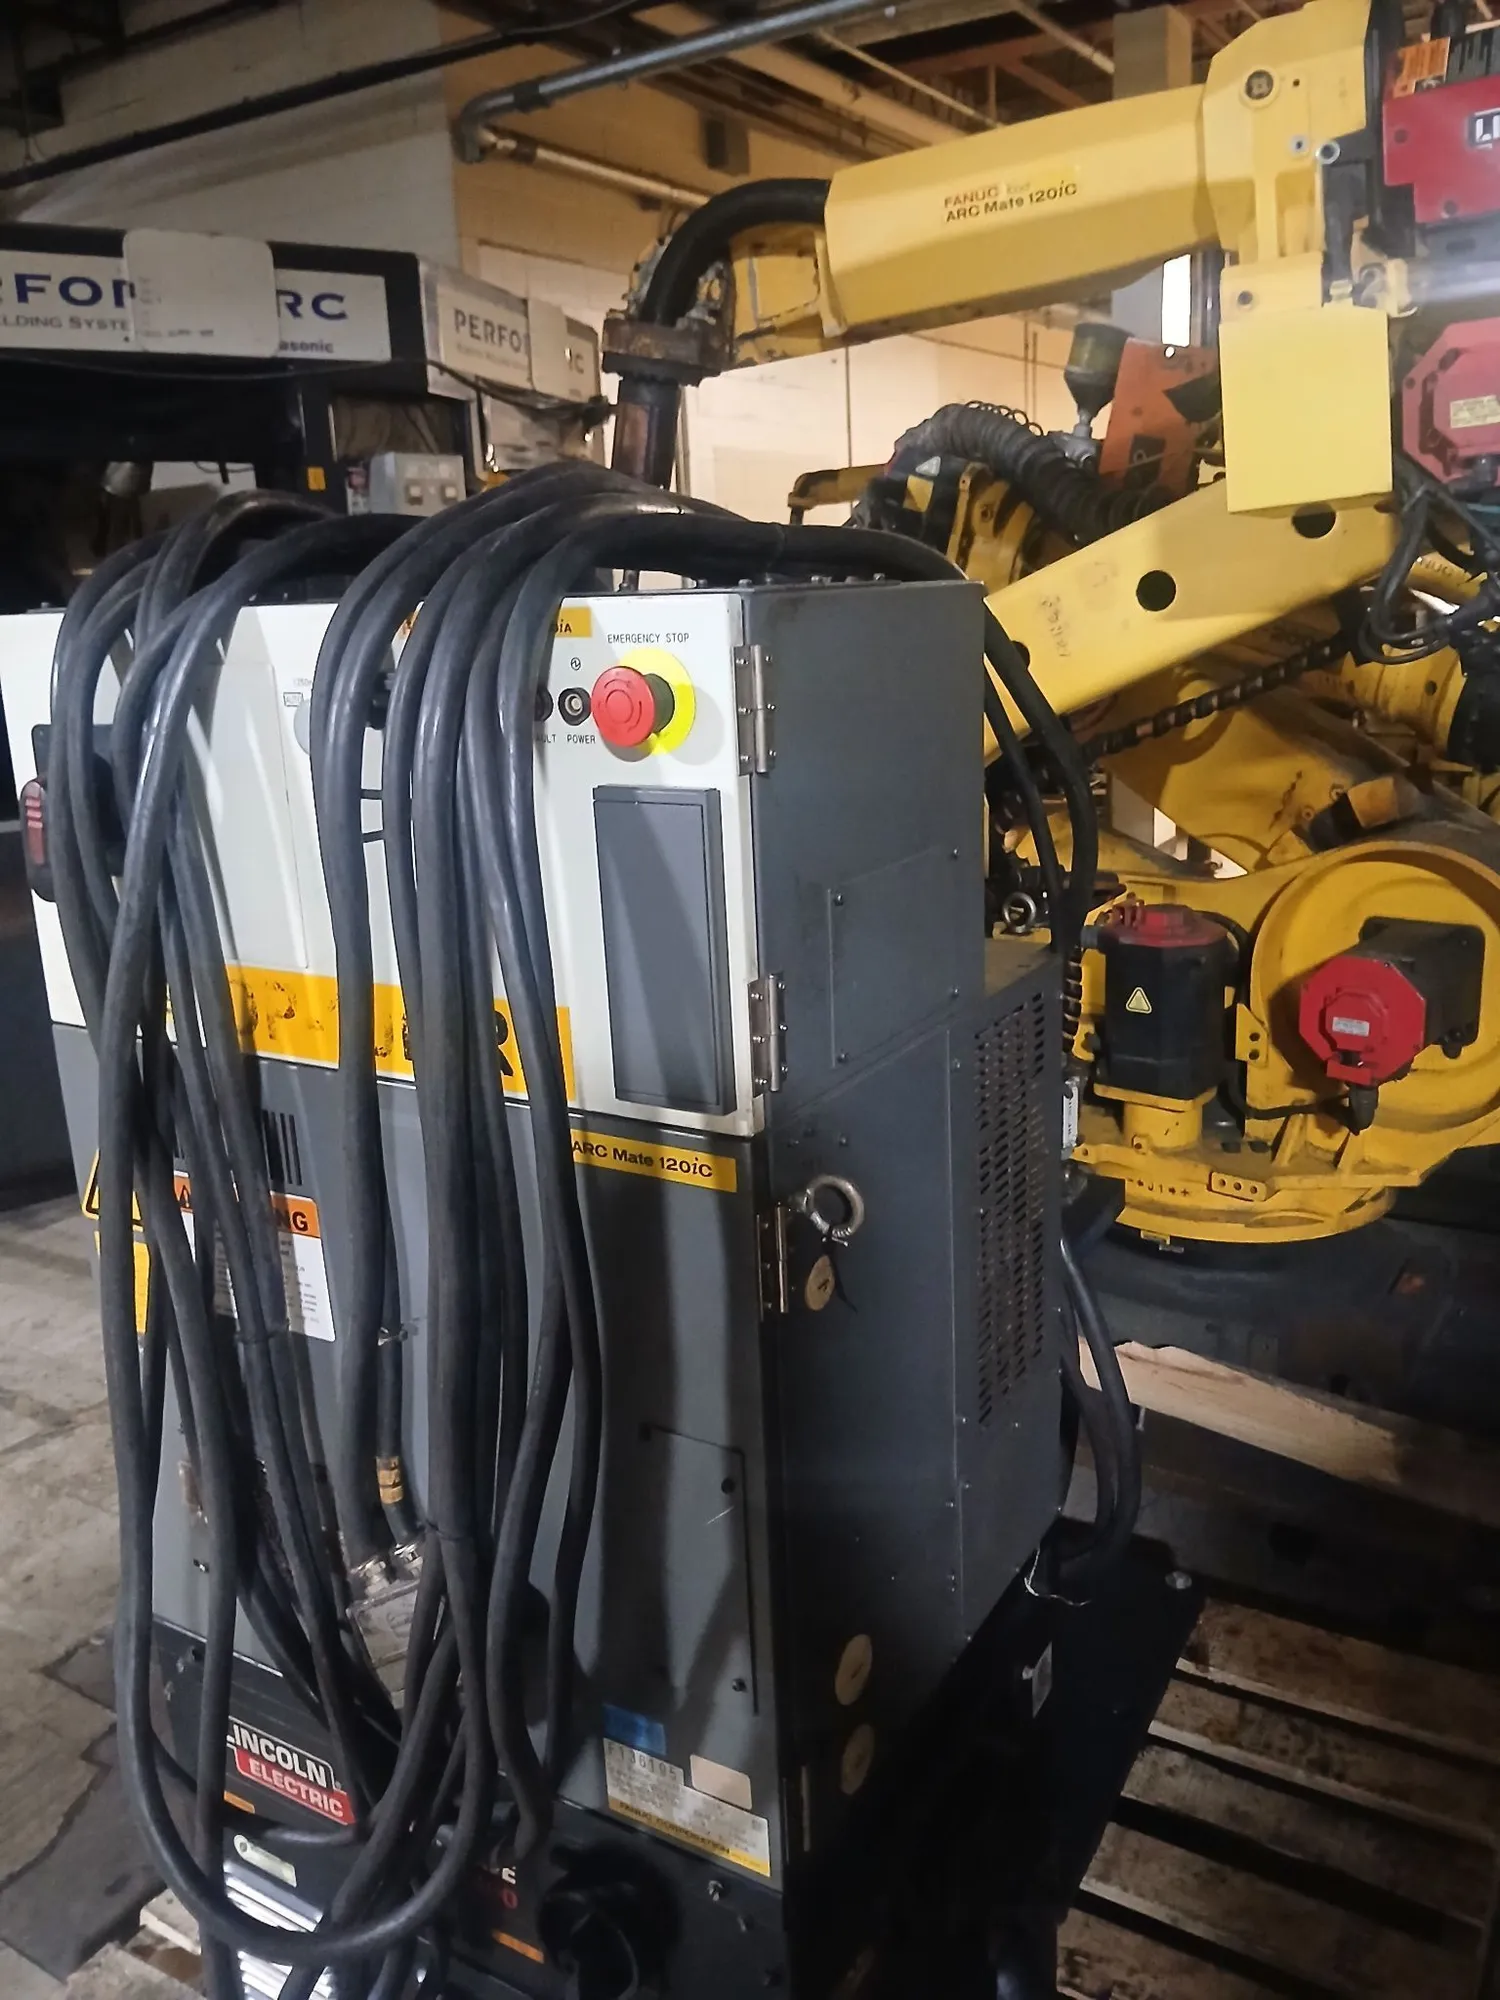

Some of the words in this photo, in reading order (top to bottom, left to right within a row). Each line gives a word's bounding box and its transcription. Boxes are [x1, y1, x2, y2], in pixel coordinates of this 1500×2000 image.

[944, 183, 999, 208] FANUC
[946, 205, 981, 222] ARC
[984, 197, 1025, 214] Mate
[1029, 180, 1077, 204] 120iC
[607, 633, 661, 644] EMERGENCY
[666, 632, 690, 643] STOP
[567, 734, 596, 744] POWER
[572, 1141, 607, 1158] ARC
[612, 1148, 653, 1167] Mate
[659, 1156, 713, 1178] 120iC
[226, 1724, 327, 1788] INCOLN
[249, 1758, 343, 1817] ELECTRIC
